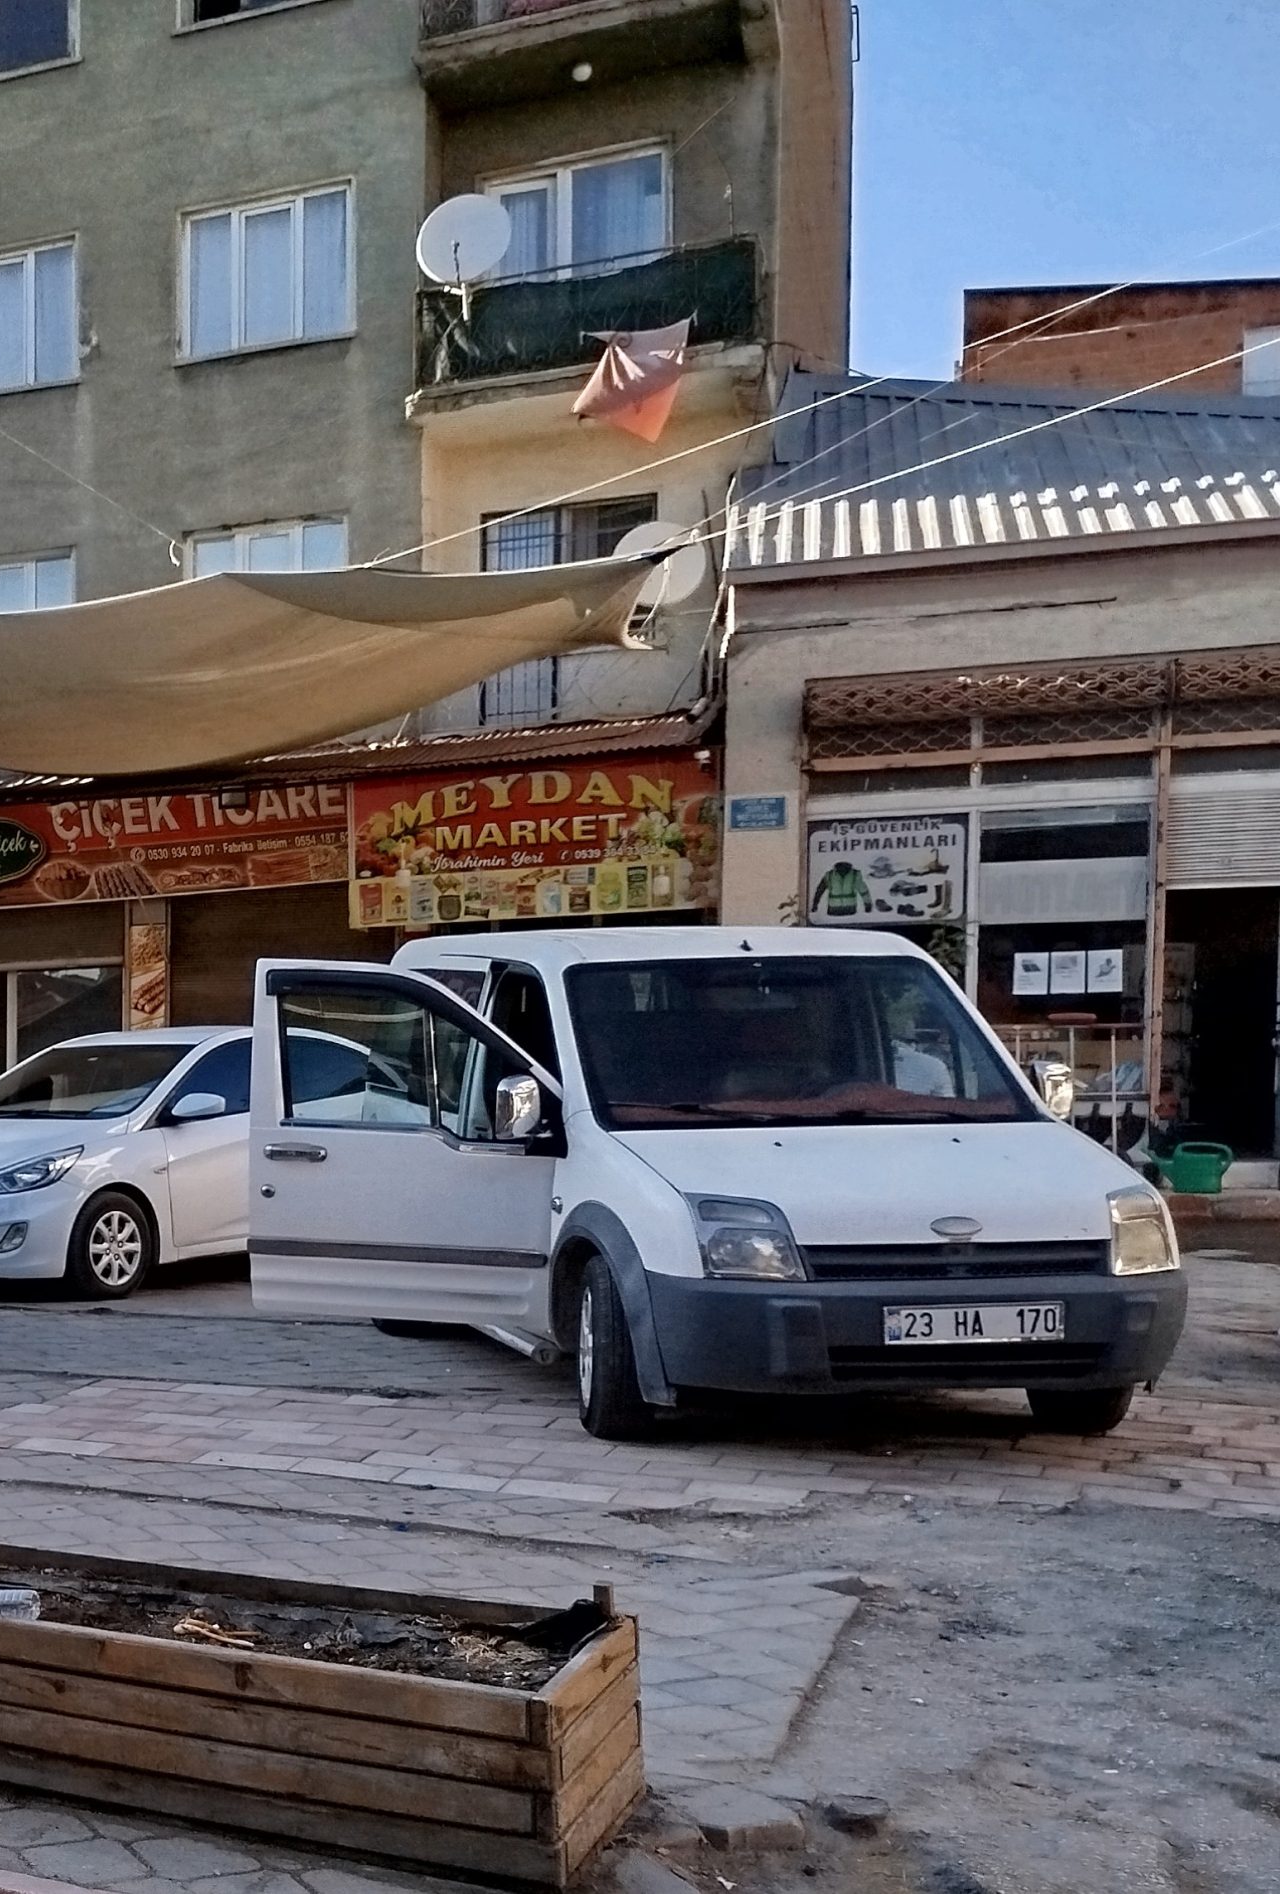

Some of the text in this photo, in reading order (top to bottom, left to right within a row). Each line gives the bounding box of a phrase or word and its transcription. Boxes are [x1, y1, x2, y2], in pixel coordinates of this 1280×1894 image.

[390, 771, 674, 837] MEYDAN
[434, 813, 628, 852] MARKET
[818, 834, 957, 853] EKİPMANLARI
[511, 850, 545, 867] Yeri
[904, 1311, 933, 1338] 23
[954, 1310, 984, 1336] HA
[1016, 1308, 1057, 1334] 170
